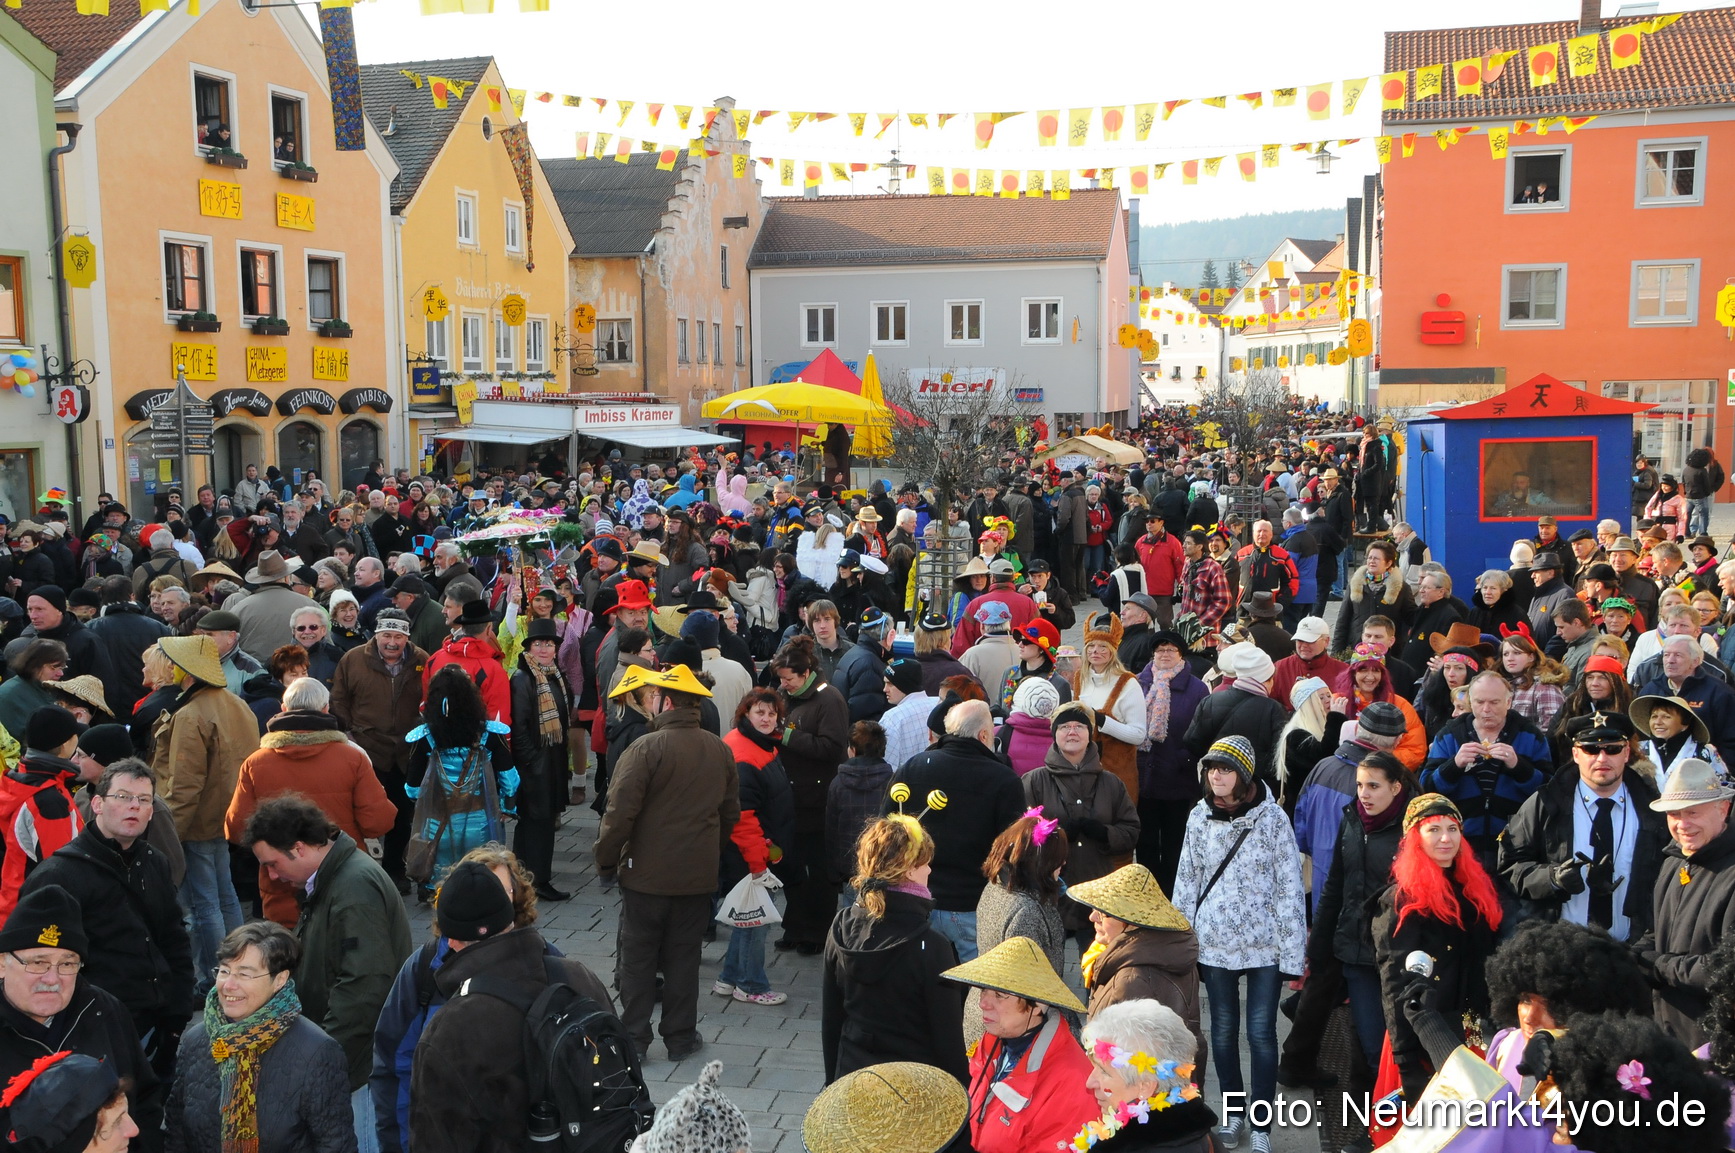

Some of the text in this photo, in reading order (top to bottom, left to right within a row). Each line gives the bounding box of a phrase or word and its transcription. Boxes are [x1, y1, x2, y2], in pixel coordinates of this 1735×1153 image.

[250, 348, 270, 361] CHINA
[248, 362, 286, 380] Metzgerei
[919, 374, 995, 392] hierl
[224, 391, 247, 414] Xaver
[289, 390, 336, 413] FEINKOST
[355, 390, 387, 406] IMBISS
[459, 390, 475, 401] CHINA
[1529, 384, 1551, 408] 天
[585, 408, 673, 423] Imbiss Krämer
[734, 920, 762, 928] TITAN
